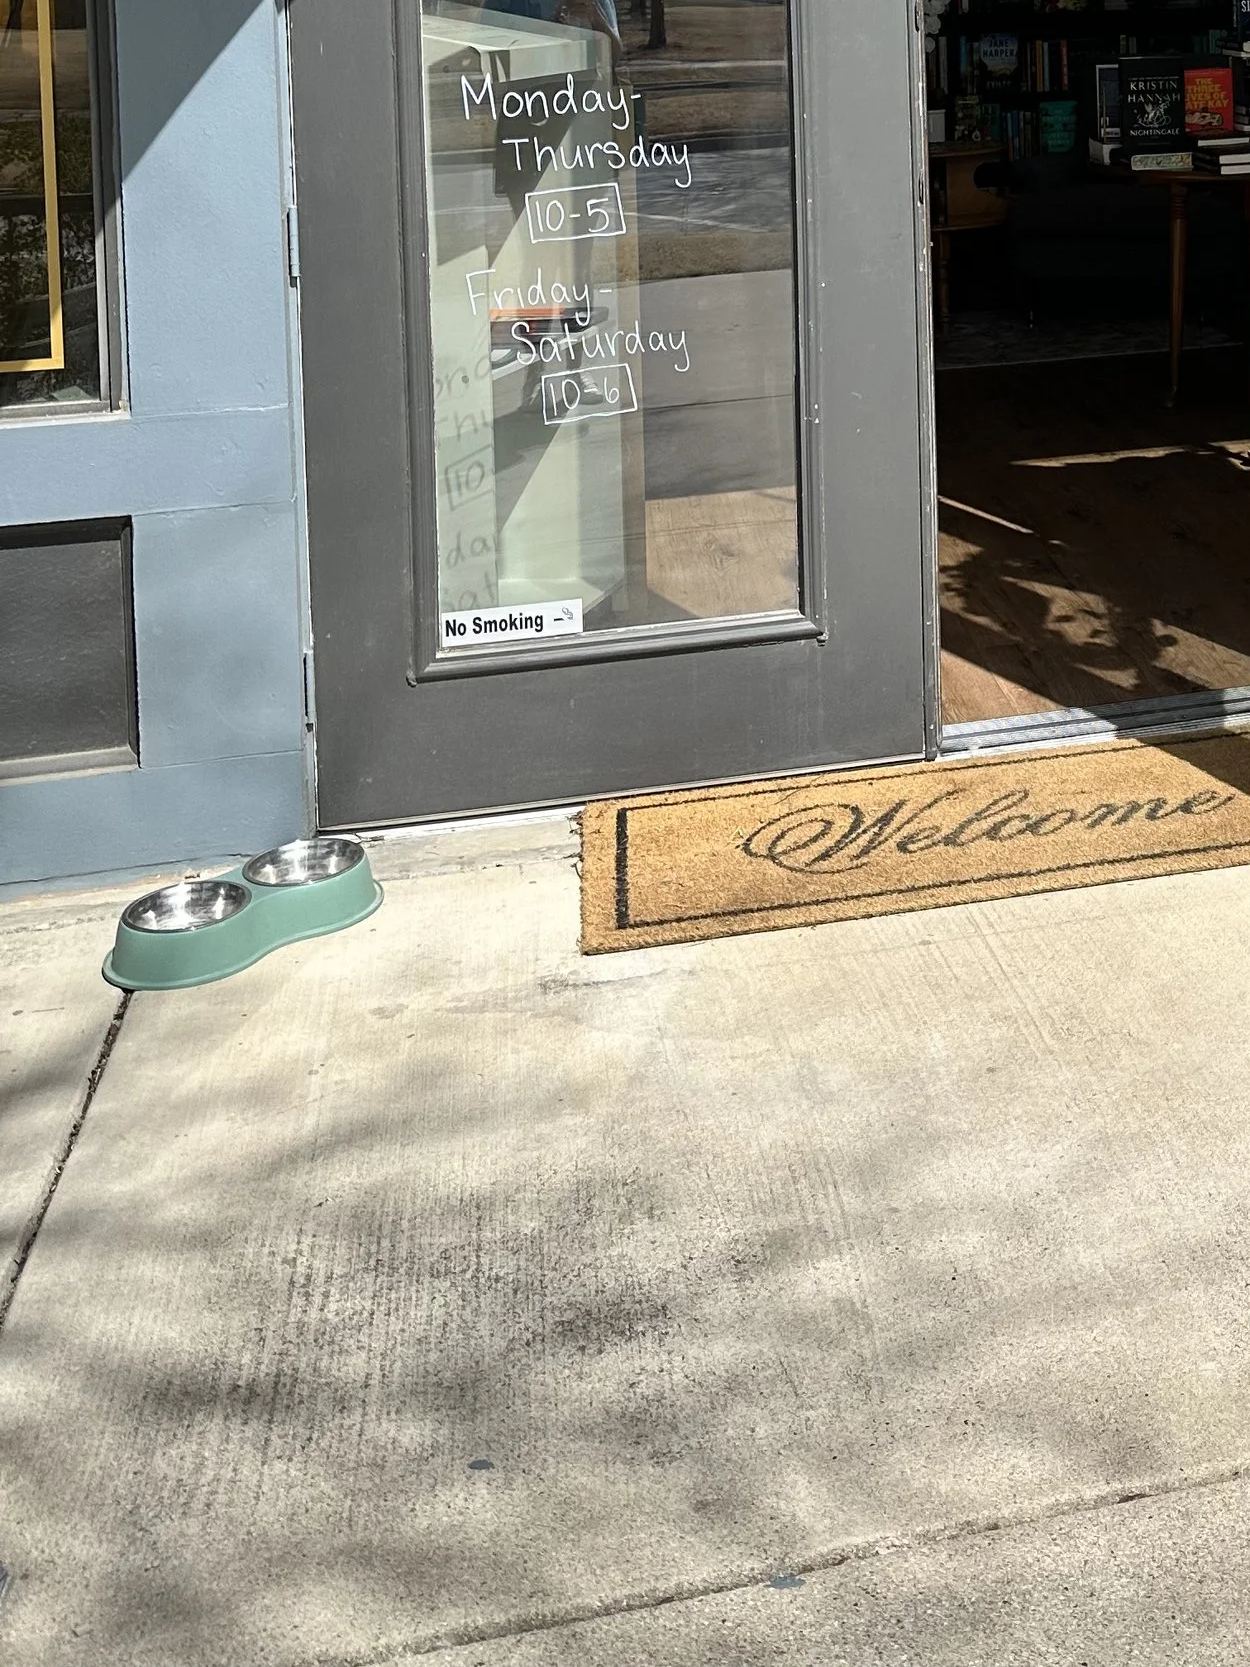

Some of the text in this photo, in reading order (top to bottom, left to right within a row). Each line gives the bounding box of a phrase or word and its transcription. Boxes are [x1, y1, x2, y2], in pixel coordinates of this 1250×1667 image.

[989, 39, 1009, 47] JANE
[982, 48, 1014, 58] HARPER
[1129, 80, 1178, 91] KRISTIN
[460, 72, 642, 131] Monday-
[1127, 93, 1180, 103] HANNAH
[1184, 93, 1211, 101] IVES
[1185, 101, 1206, 109] ATE
[1130, 127, 1180, 136] NIGHTINGALE
[501, 135, 692, 188] Thursday
[535, 197, 610, 233] 10-5
[511, 320, 690, 373] Saturday
[550, 377, 620, 417] 10-6
[445, 612, 544, 637] No Smoking
[741, 785, 1237, 876] Welcome
